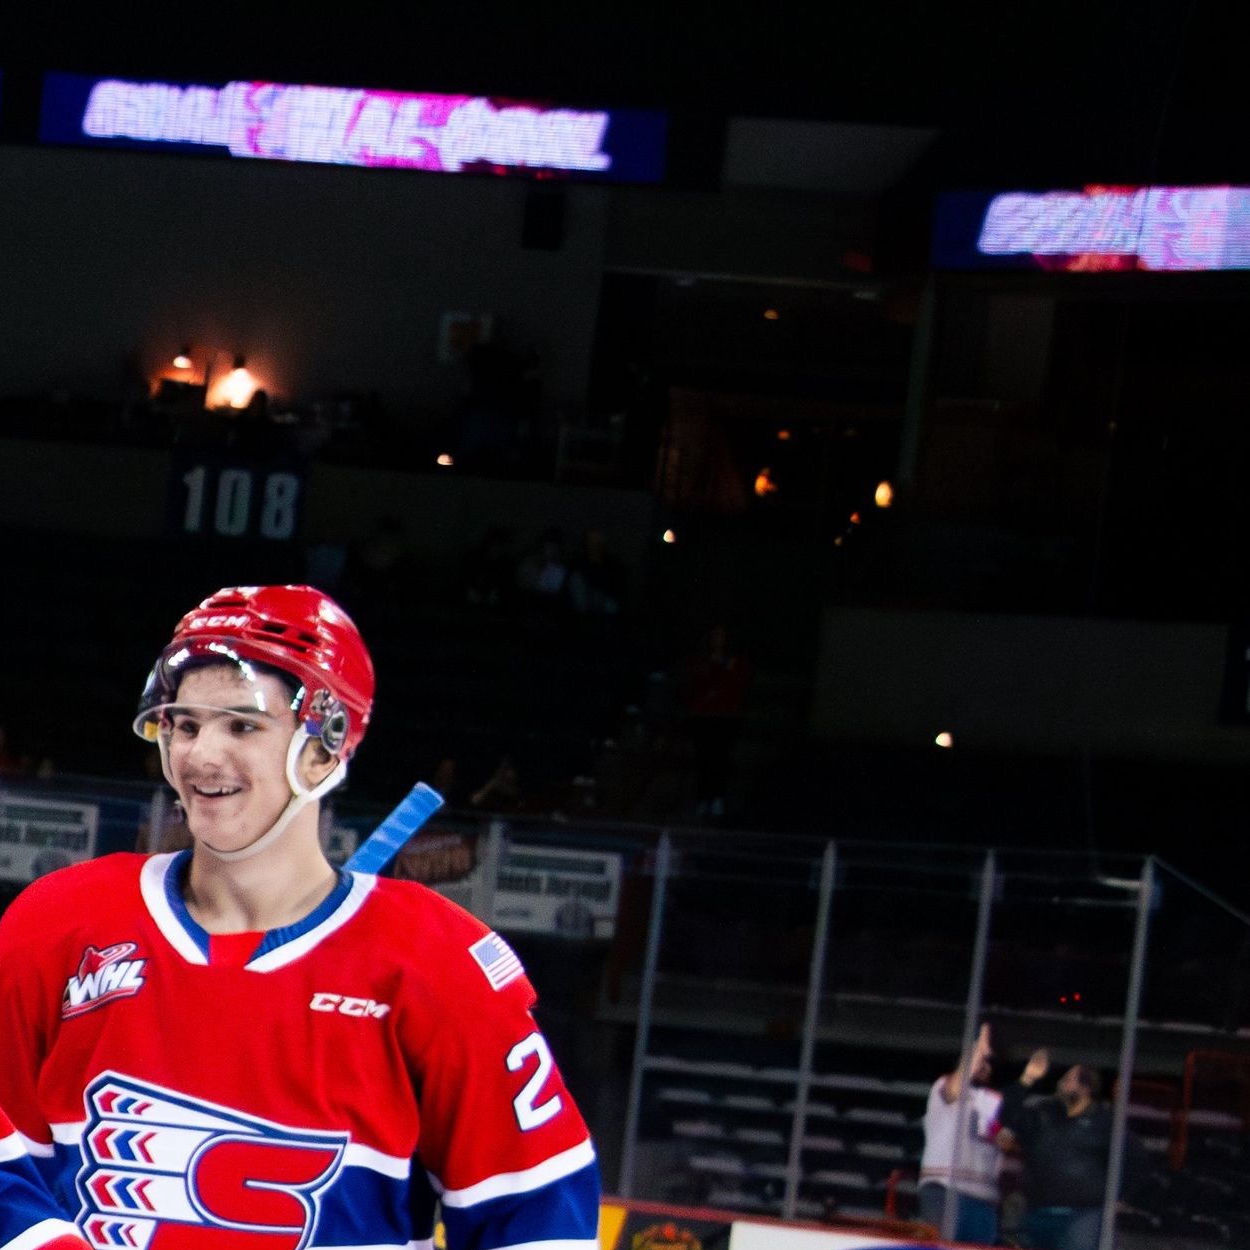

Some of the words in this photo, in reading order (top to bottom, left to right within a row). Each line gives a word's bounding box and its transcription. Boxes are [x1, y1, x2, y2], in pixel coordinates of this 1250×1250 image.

[182, 465, 299, 540] 108
[188, 615, 250, 629] CCM
[66, 959, 148, 1006] WHL
[309, 992, 391, 1019] CCM
[504, 1030, 563, 1133] 2
